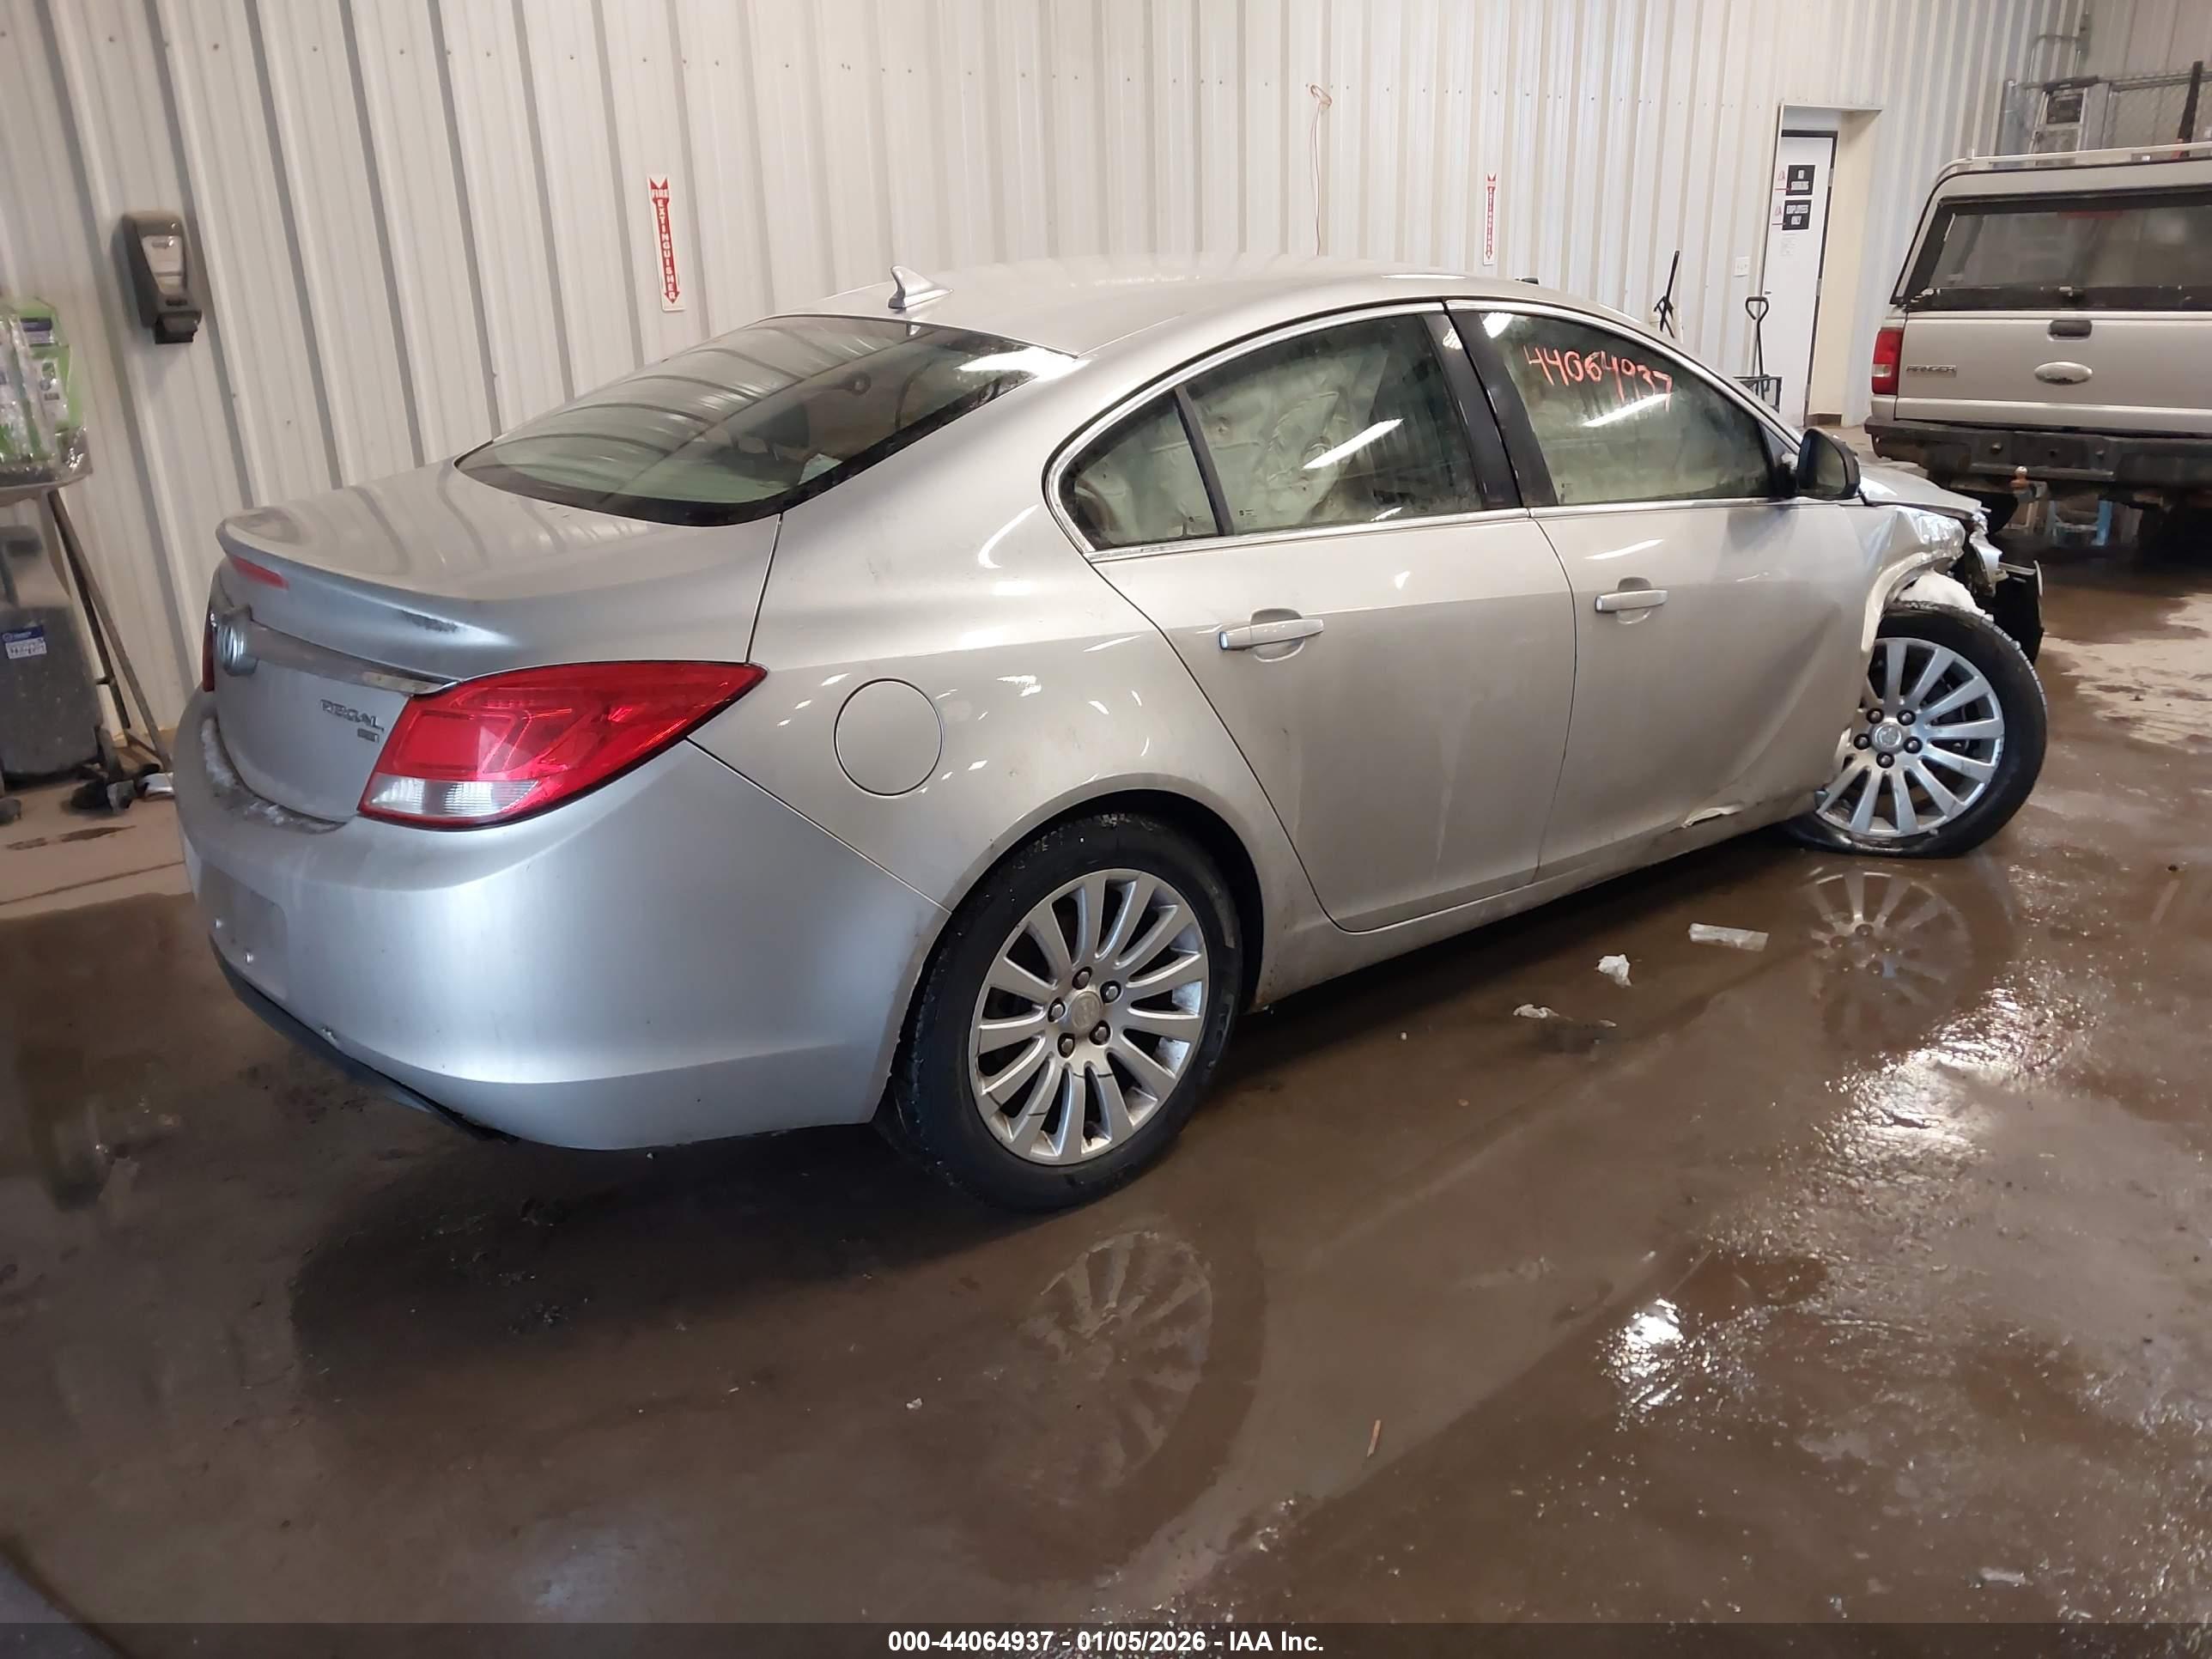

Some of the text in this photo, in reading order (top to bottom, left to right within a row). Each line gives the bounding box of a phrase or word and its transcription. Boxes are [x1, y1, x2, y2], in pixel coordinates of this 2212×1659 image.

[651, 189, 670, 198] FIRE
[657, 198, 677, 300] EXTINGUISHER
[1522, 344, 1674, 407] 44064937
[319, 698, 385, 732] REGAL
